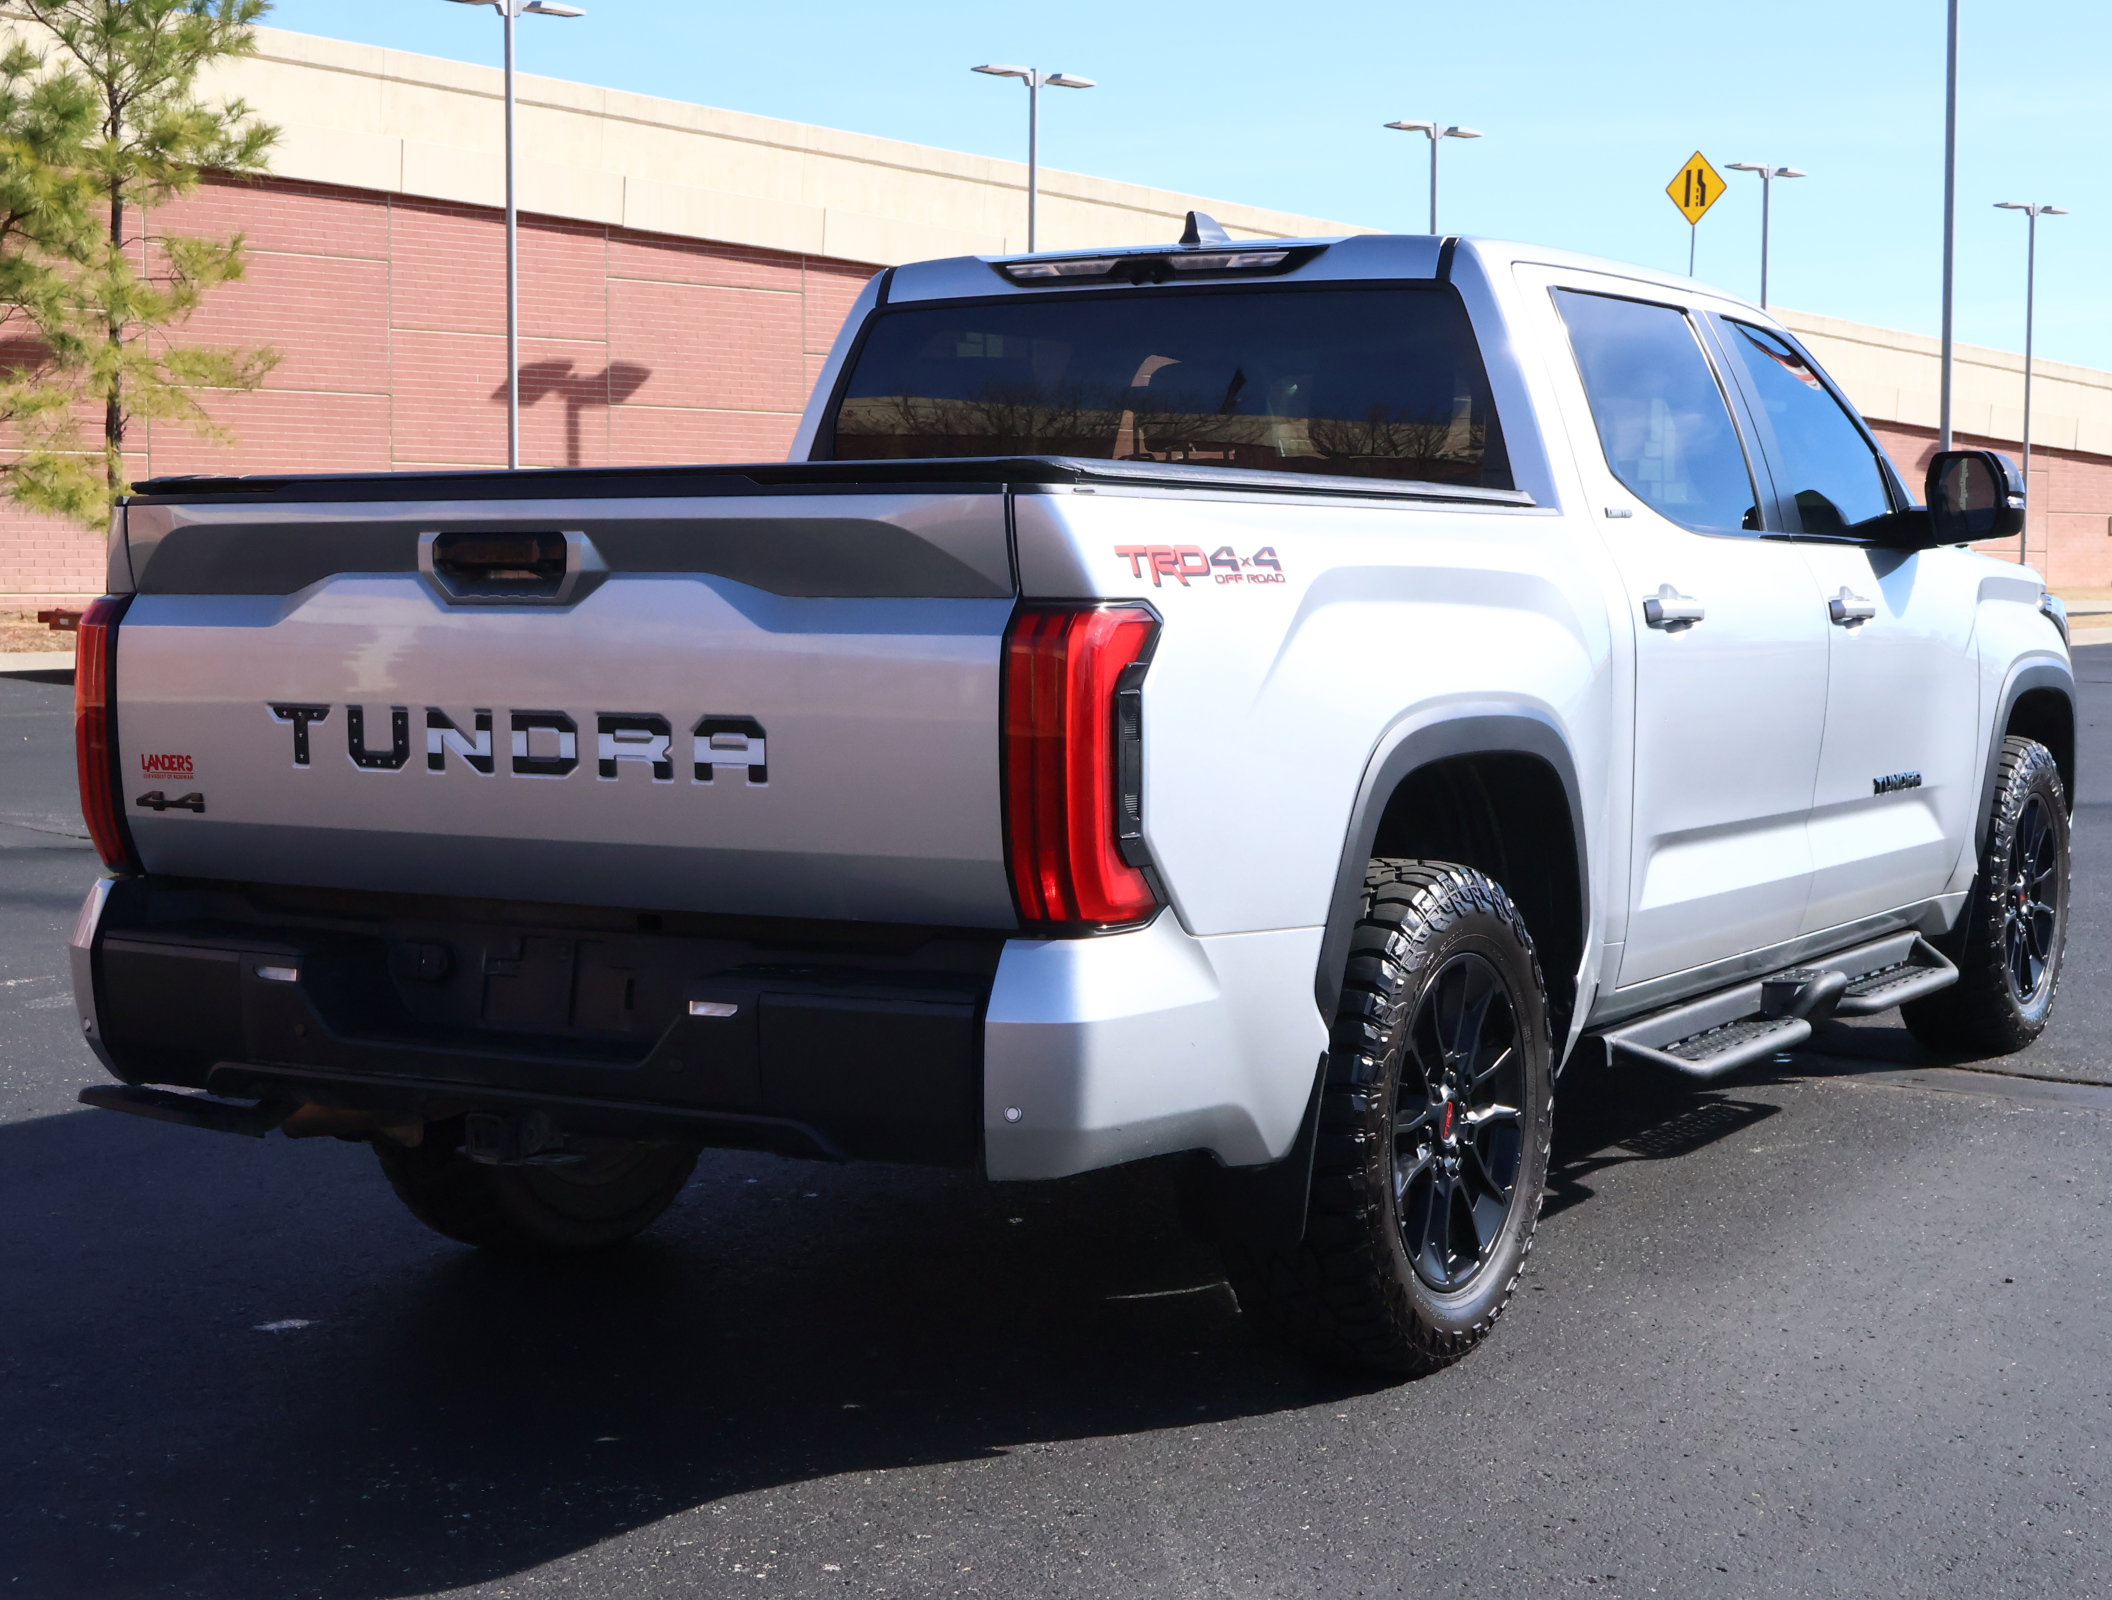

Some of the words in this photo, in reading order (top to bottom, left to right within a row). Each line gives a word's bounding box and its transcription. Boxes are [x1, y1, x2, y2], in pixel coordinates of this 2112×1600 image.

[1114, 545, 1211, 587] TRD
[1209, 546, 1283, 572] 4x4
[1215, 574, 1244, 584] OFF
[1247, 573, 1286, 584] ROAD
[267, 702, 768, 787] TUNDRA
[141, 753, 194, 772] LANDERS
[136, 790, 206, 813] 4x4
